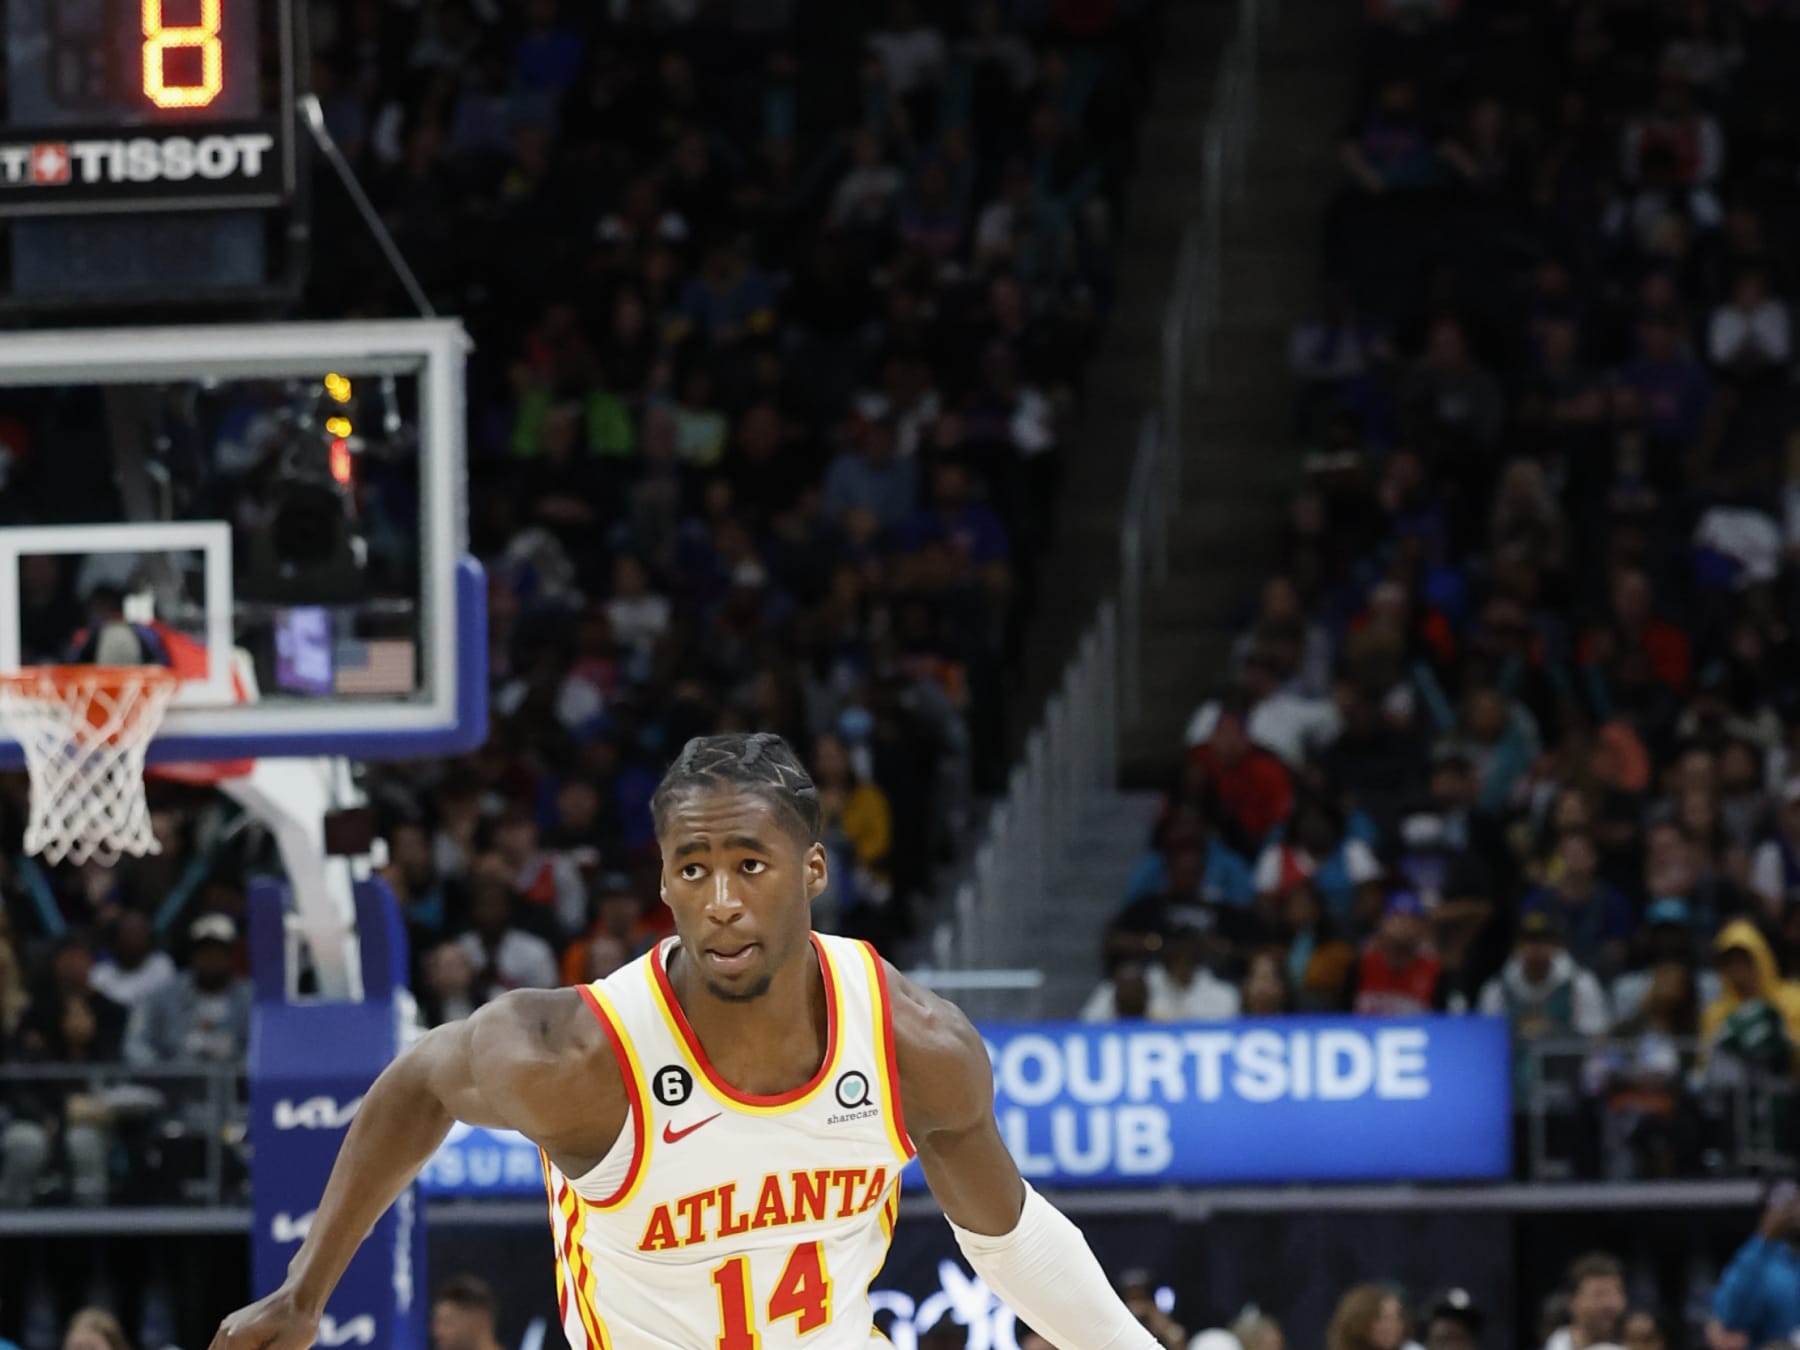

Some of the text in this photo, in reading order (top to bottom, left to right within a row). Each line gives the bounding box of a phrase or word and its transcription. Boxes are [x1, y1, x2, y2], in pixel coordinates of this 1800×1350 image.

[72, 133, 273, 183] TISSOT
[661, 1071, 684, 1101] 6
[827, 1108, 879, 1125] sharecare
[996, 1105, 1174, 1176] LUB
[639, 1166, 888, 1252] ATLANTA
